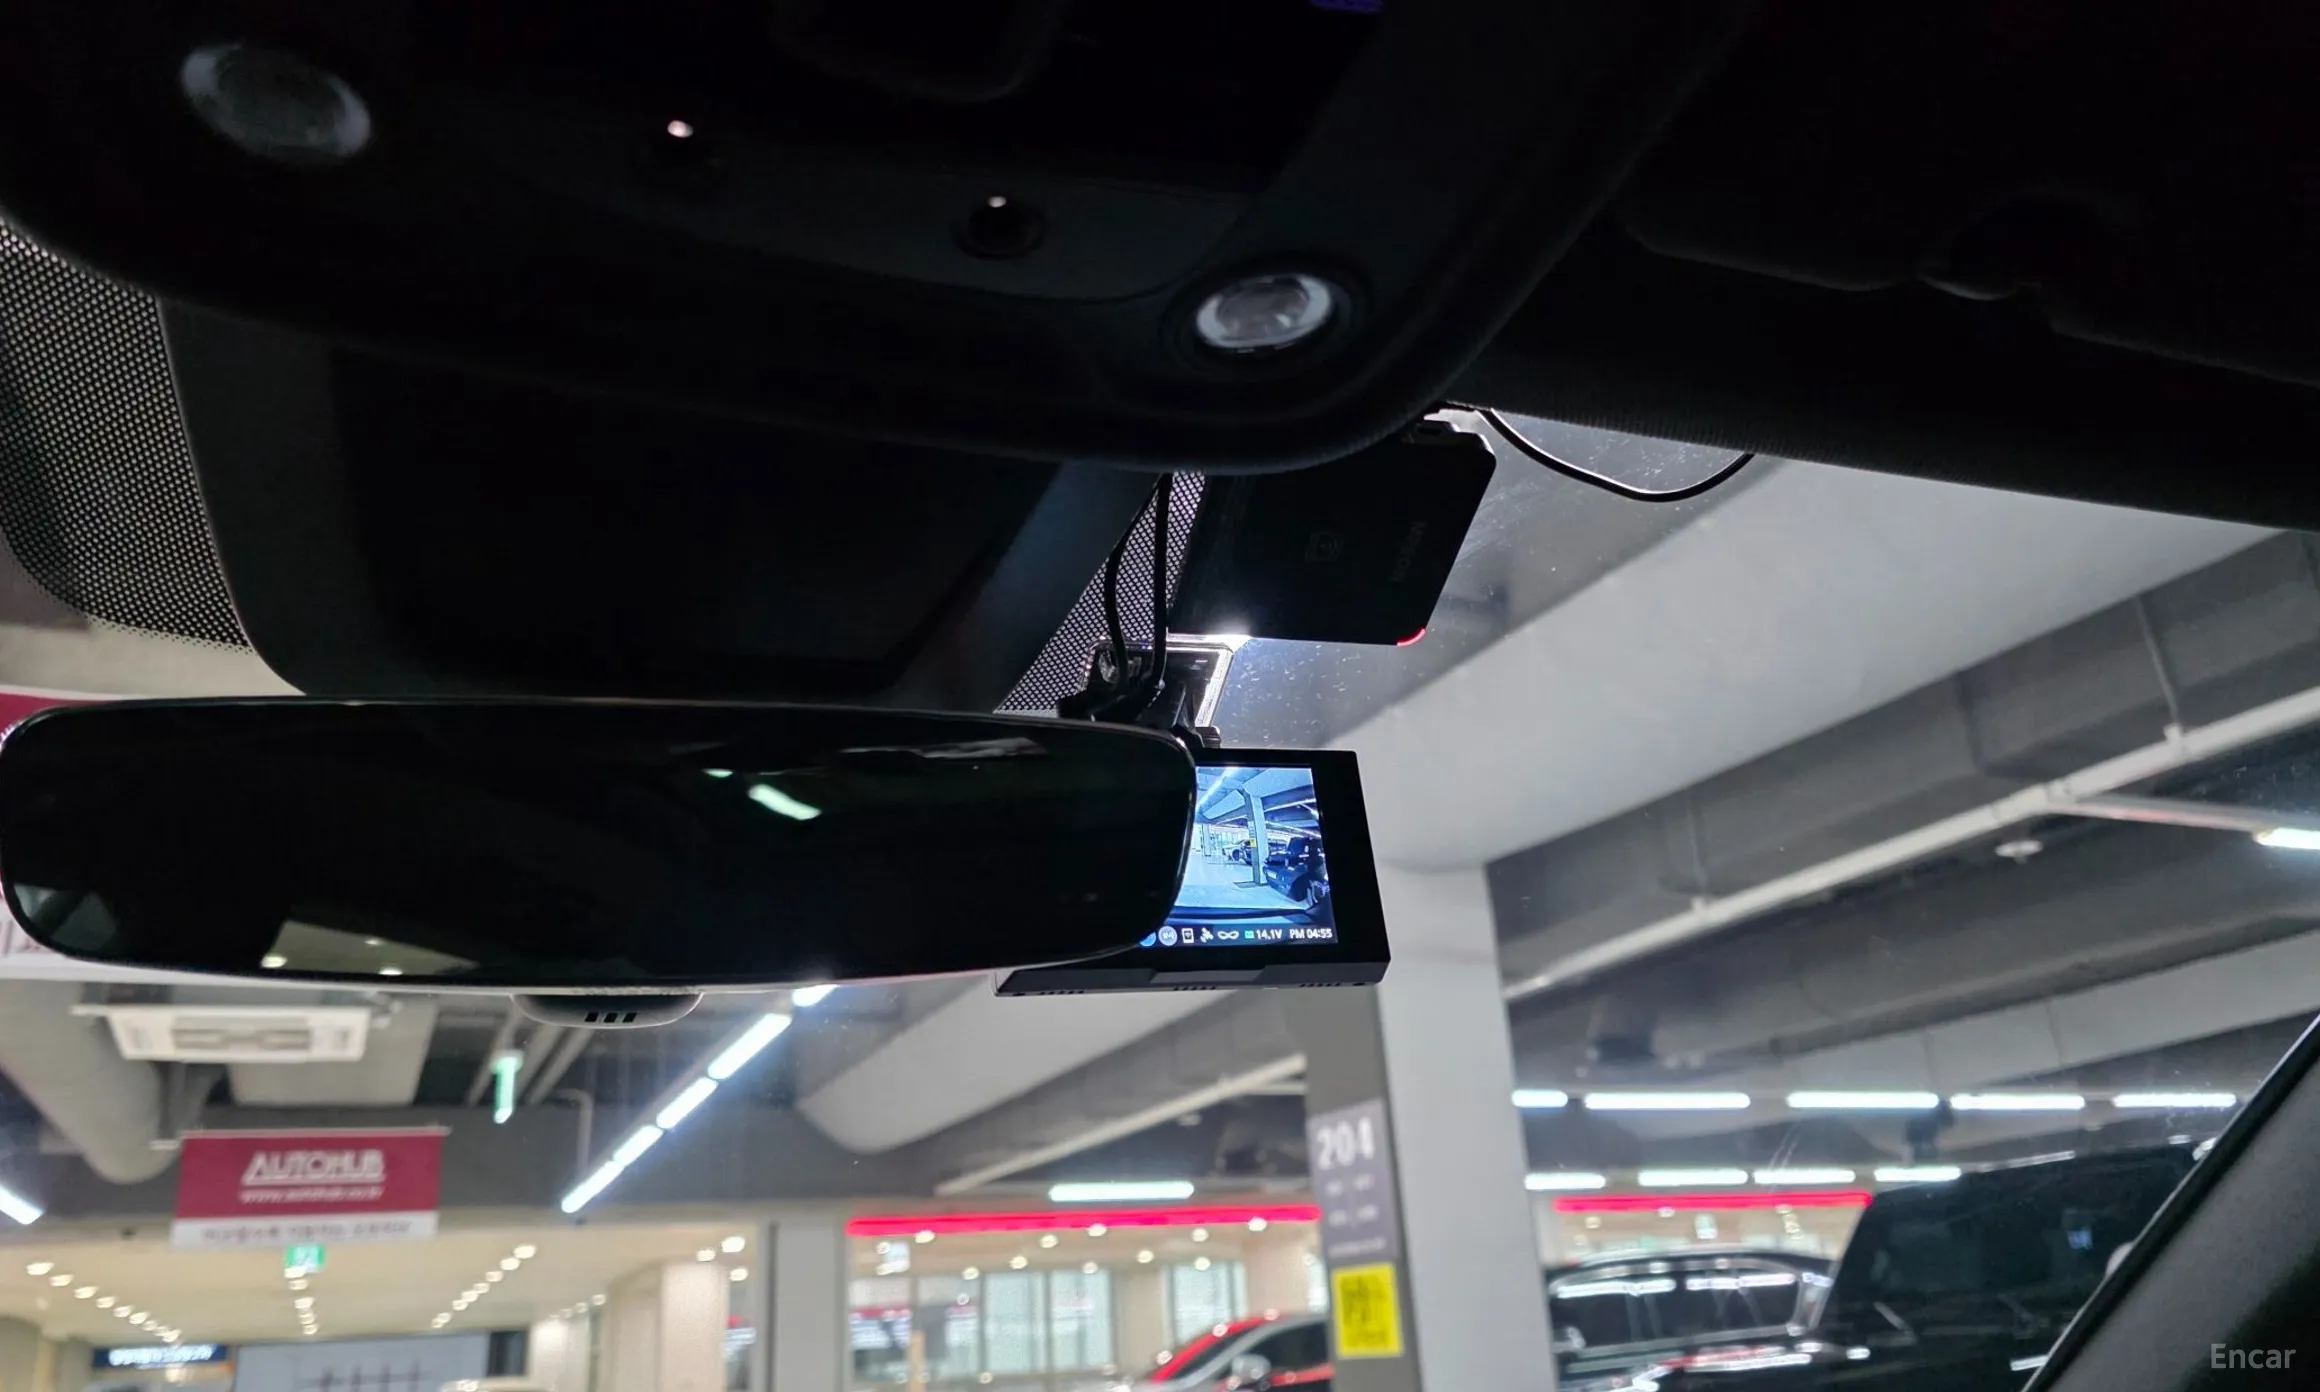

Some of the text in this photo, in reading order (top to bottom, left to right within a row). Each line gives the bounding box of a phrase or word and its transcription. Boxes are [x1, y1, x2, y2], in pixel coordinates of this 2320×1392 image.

[1256, 928, 1333, 940] 14.1V PM 04:55
[240, 1150, 385, 1184] AUTOHUB
